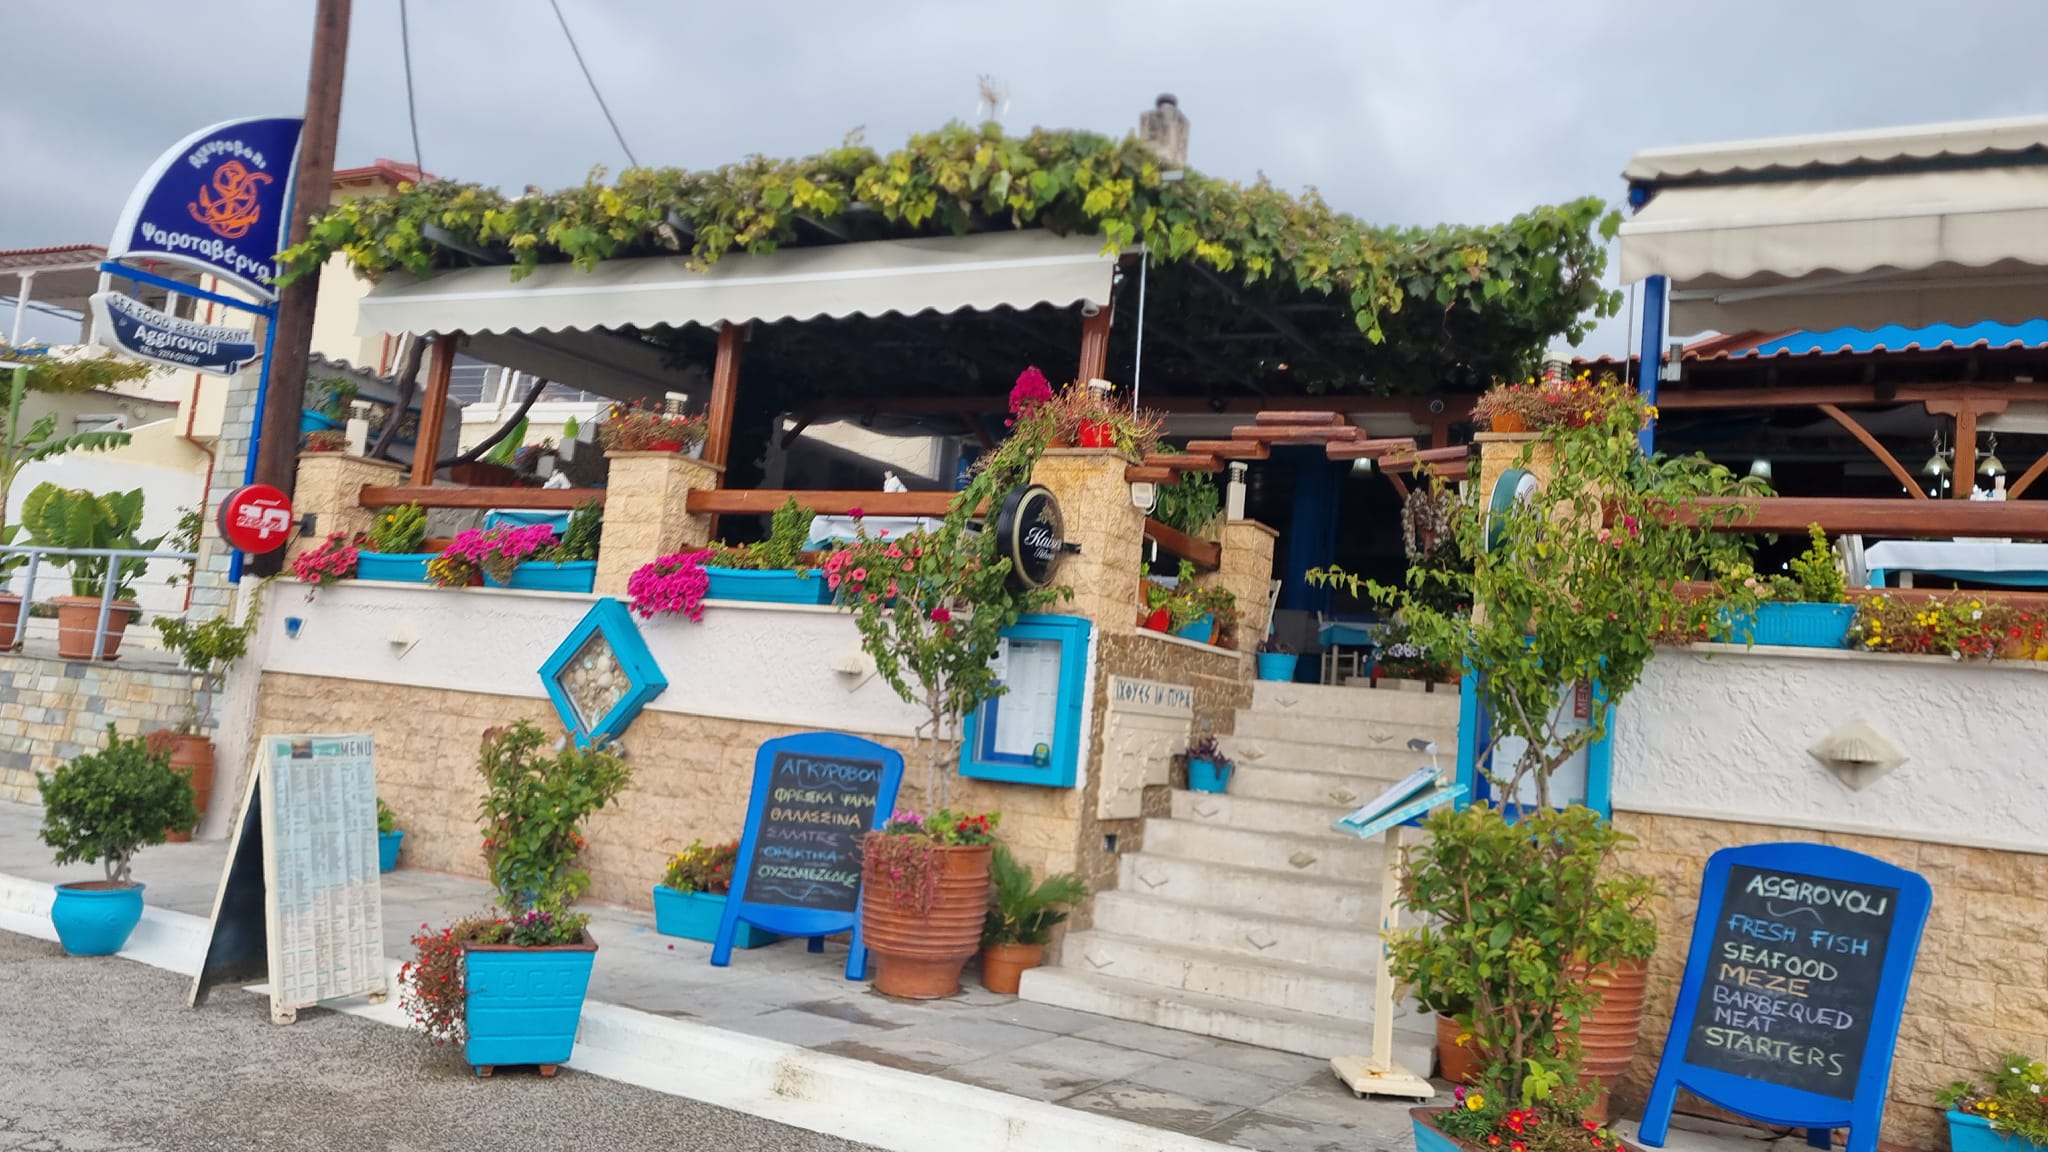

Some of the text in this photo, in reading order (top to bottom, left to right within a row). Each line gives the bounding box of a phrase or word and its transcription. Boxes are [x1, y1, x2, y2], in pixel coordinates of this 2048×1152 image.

[133, 325, 218, 356] Aggirovoli
[137, 307, 171, 329] FOOD
[175, 321, 250, 343] RESTAURANT
[341, 740, 372, 758] MENU
[1727, 913, 1868, 957] FRESH FISH
[1723, 941, 1838, 982] SEAFOOD
[1719, 963, 1810, 998] MEZE
[1713, 984, 1854, 1030] BARBEQUED
[1714, 1005, 1776, 1033] MEAT
[1705, 1026, 1847, 1077] STARTERS
